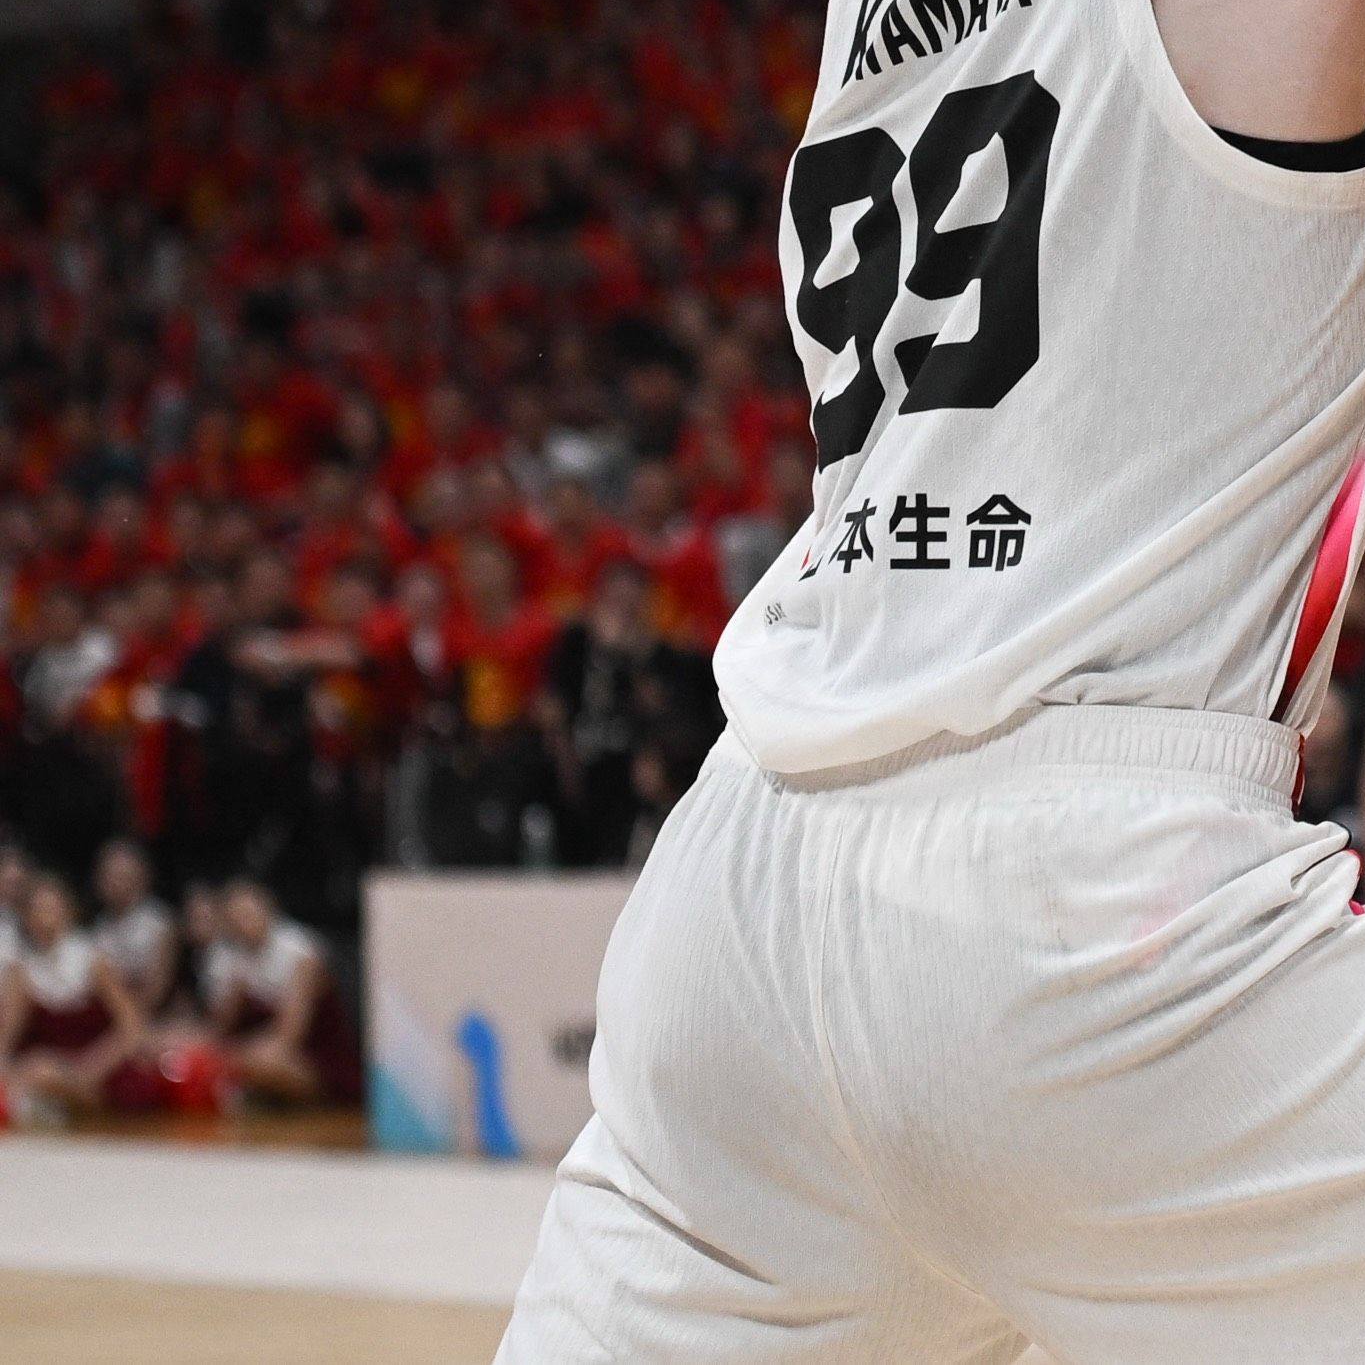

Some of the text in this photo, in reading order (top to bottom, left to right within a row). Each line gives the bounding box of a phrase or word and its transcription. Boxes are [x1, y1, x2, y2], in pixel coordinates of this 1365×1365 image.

[789, 70, 1061, 474] 99
[798, 492, 1033, 582] 本生命
